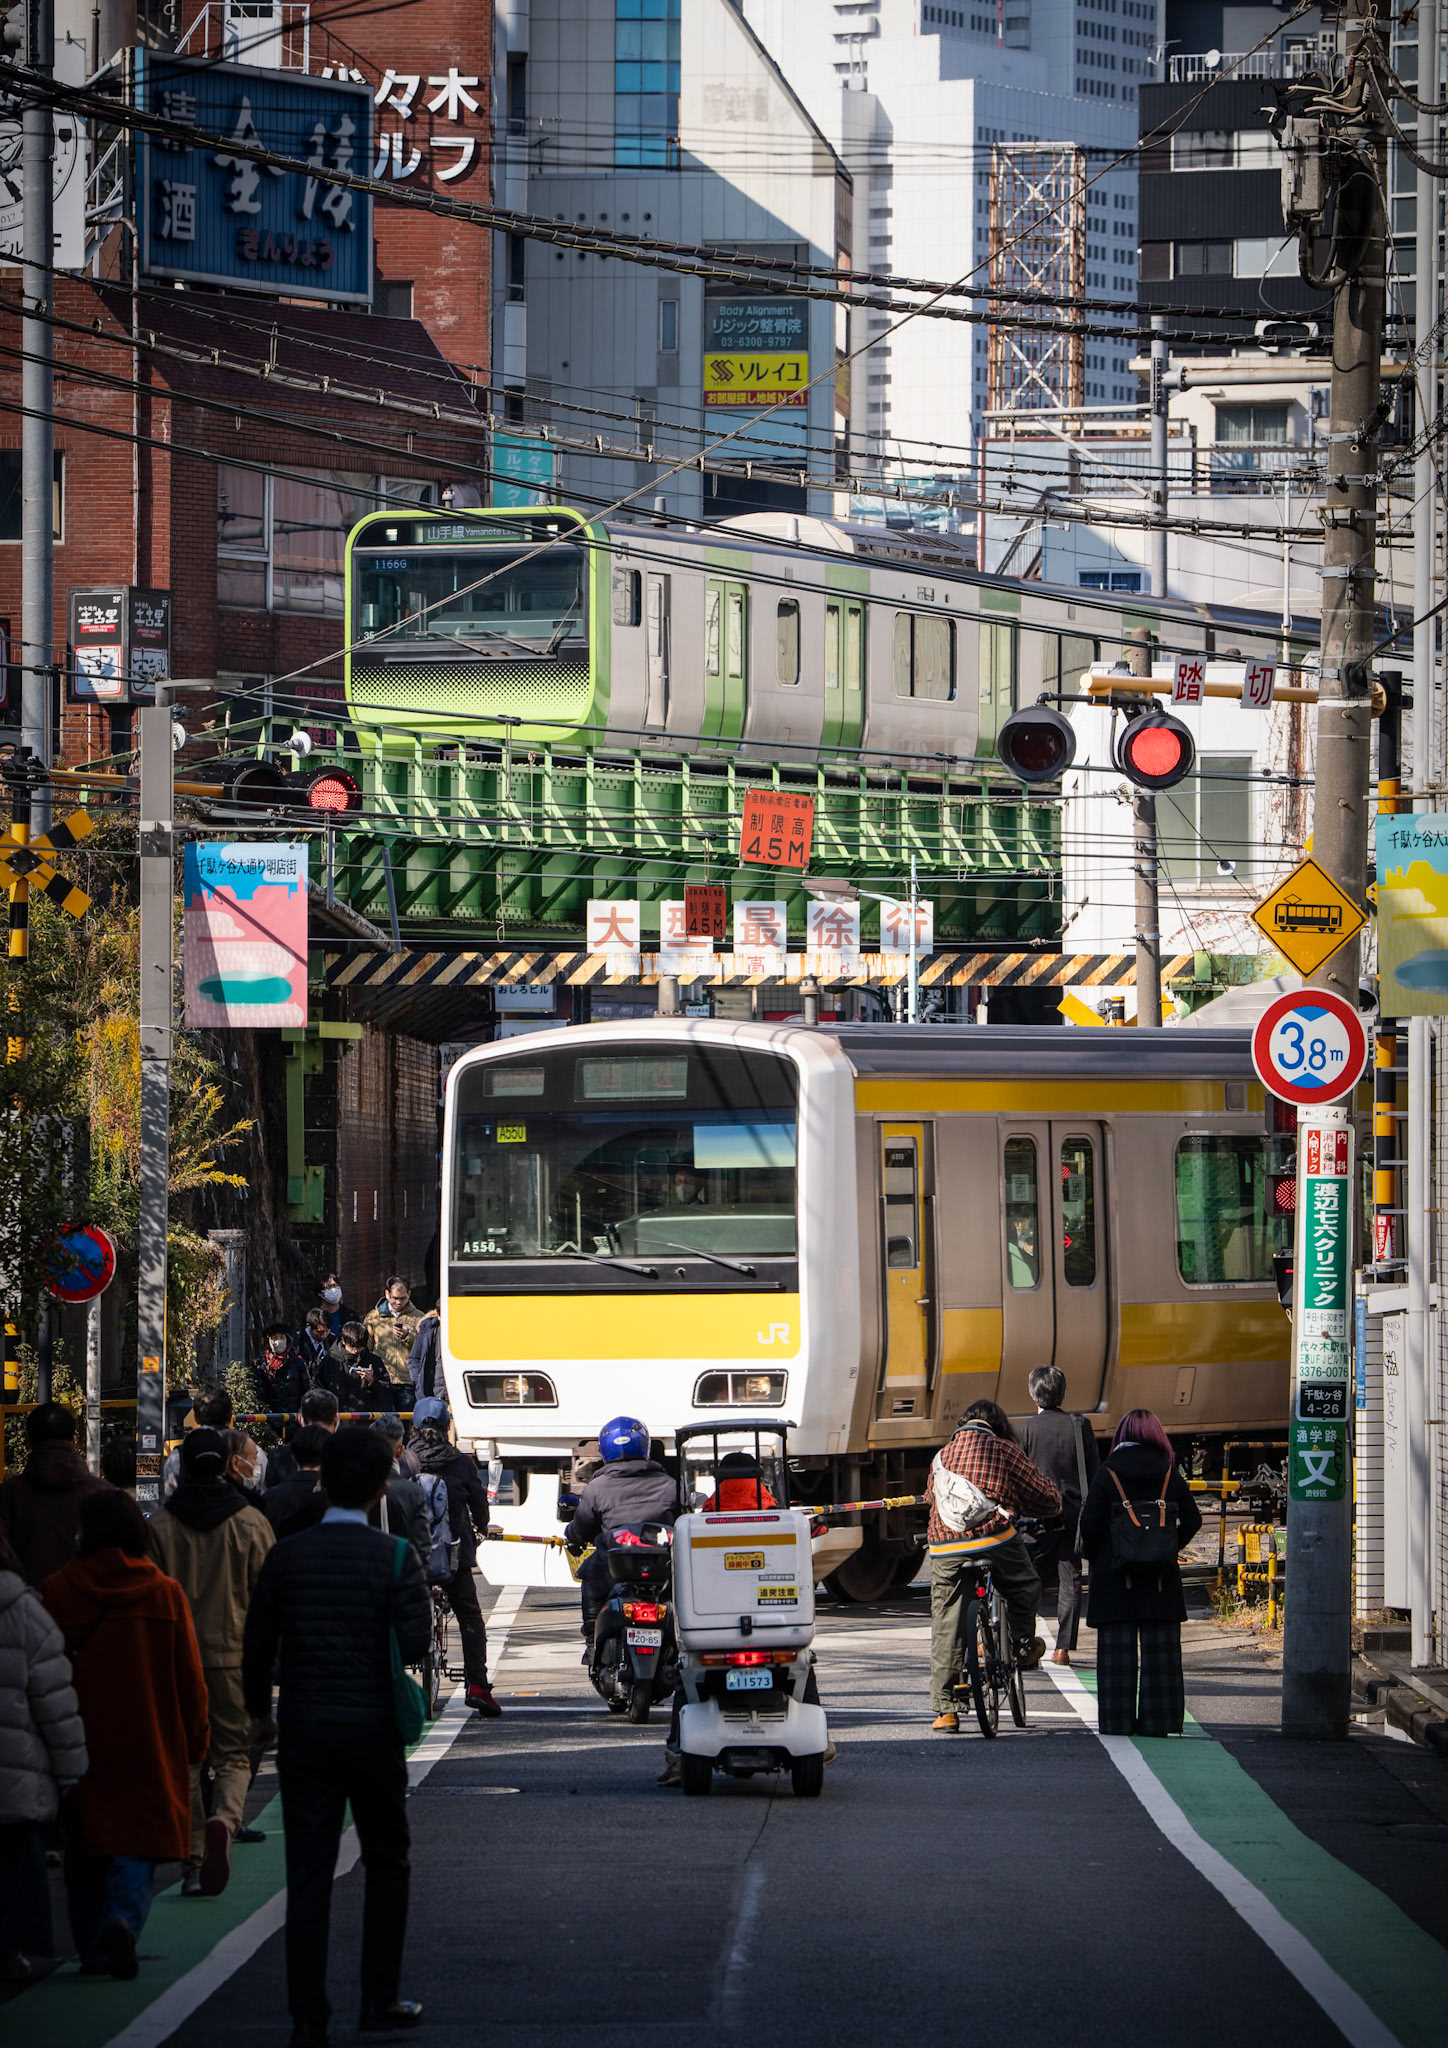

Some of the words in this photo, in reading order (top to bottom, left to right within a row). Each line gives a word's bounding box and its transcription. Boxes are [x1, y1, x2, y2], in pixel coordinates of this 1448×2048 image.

[719, 306, 746, 317] Body
[746, 306, 794, 317] Alignment
[712, 318, 802, 334] リジック整骨院
[721, 337, 792, 347] 03-6300-9797
[427, 525, 465, 540] 山手線
[465, 527, 502, 538] Yamanote
[375, 559, 407, 569] 1166G
[1175, 660, 1274, 705] 踏切
[750, 812, 806, 837] 制限高
[1278, 1021, 1344, 1071] 3.8m
[1308, 1131, 1320, 1173] 人間ドック
[1313, 1182, 1339, 1307] 渡辺七六クリニック
[757, 1323, 790, 1344] JR
[1300, 1341, 1348, 1352] 代々木駅前
[1299, 1366, 1348, 1377] 3376-0076
[1304, 1389, 1343, 1401] 千駄ヶ谷
[1306, 1403, 1340, 1415] 4-26
[1296, 1429, 1337, 1443] 通学路
[760, 1588, 795, 1597] 追突注意
[737, 1677, 770, 1687] 11573
